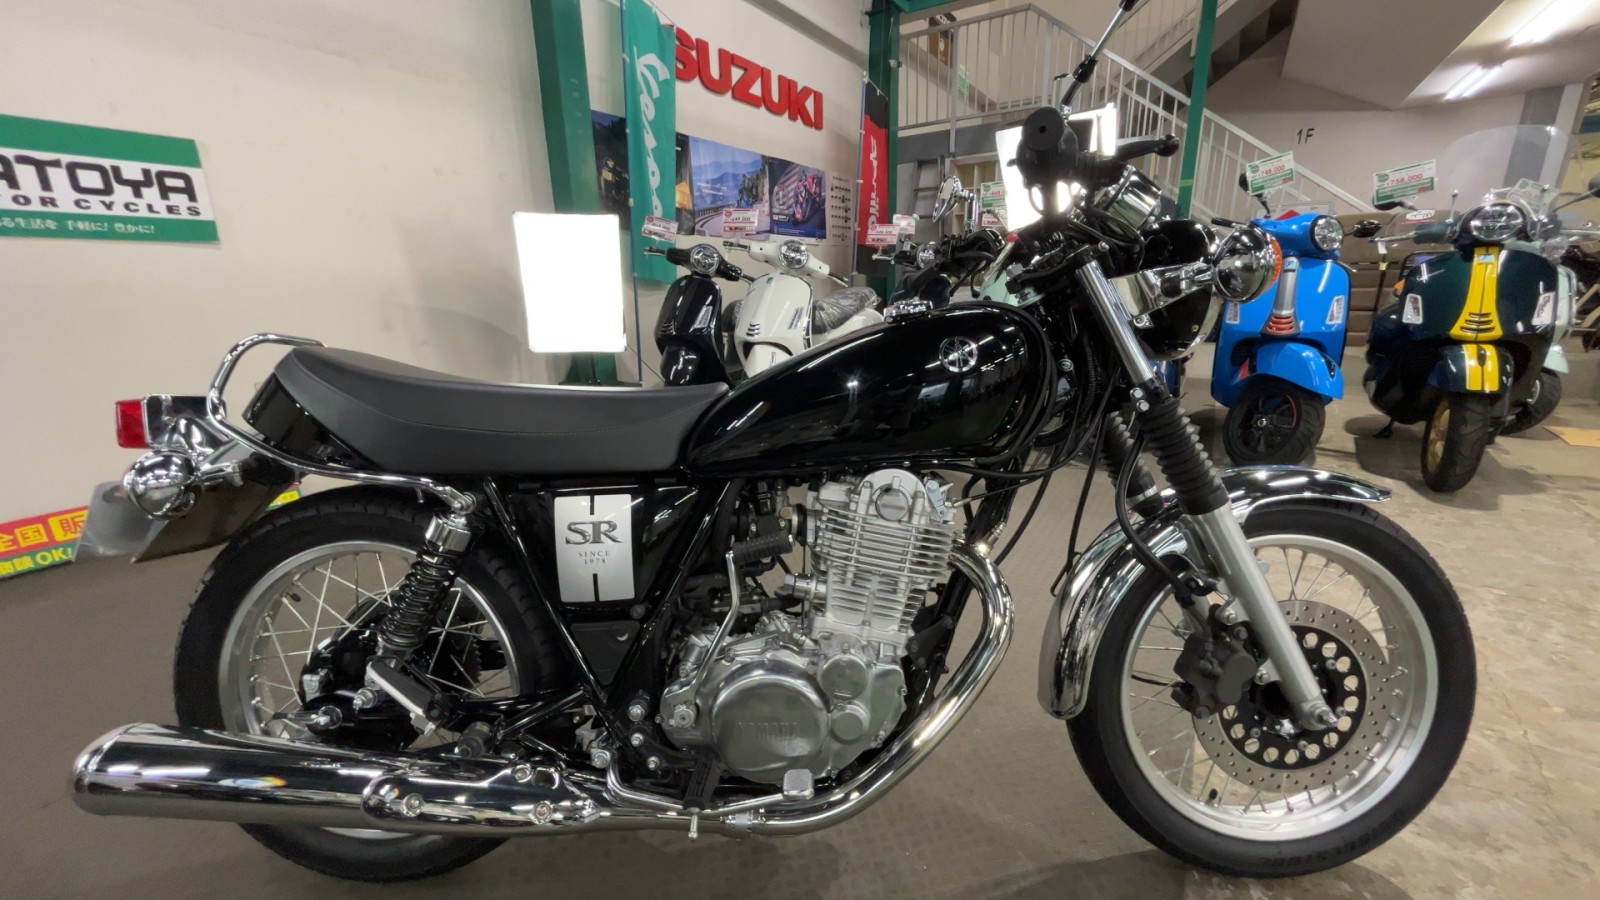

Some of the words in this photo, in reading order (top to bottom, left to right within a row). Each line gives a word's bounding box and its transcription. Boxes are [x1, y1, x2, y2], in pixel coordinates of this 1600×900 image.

[675, 27, 824, 131] SUZUKI
[633, 45, 671, 219] Vespa
[1296, 127, 1315, 145] 1F
[73, 198, 202, 217] CYCLES
[565, 520, 624, 545] SR
[578, 550, 611, 558] SINCE
